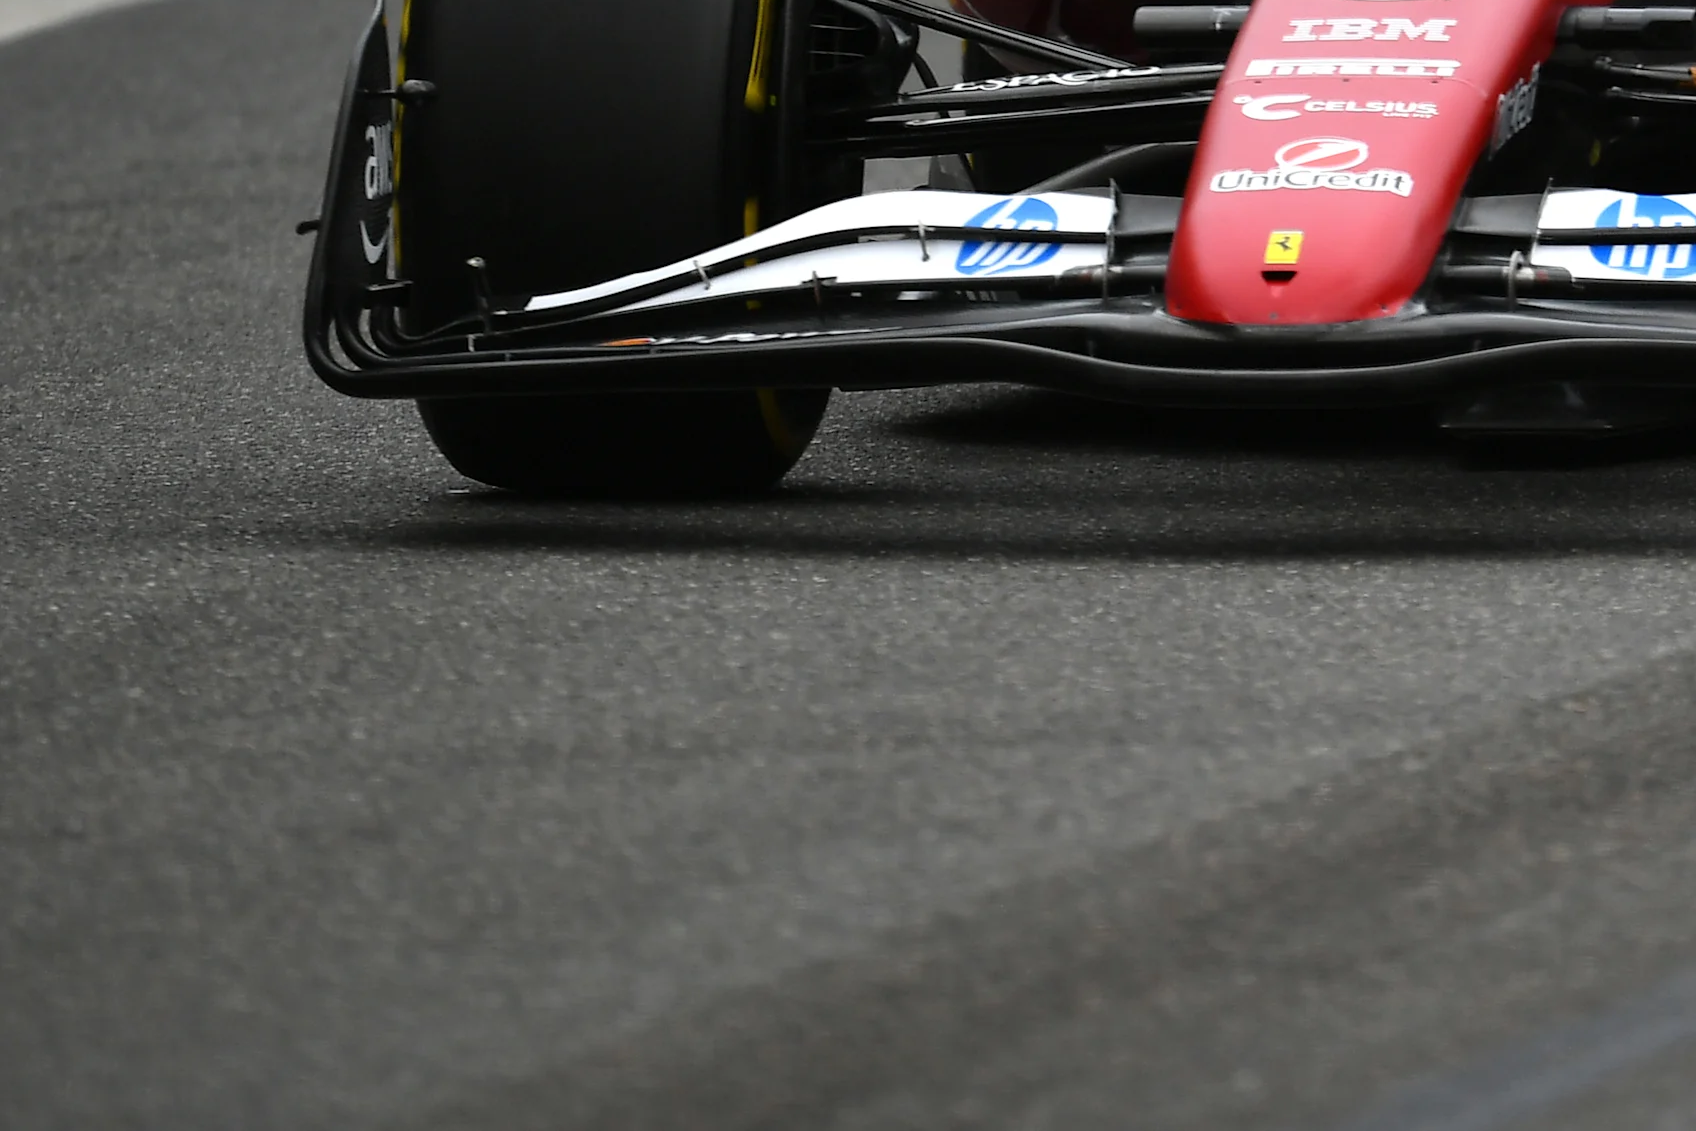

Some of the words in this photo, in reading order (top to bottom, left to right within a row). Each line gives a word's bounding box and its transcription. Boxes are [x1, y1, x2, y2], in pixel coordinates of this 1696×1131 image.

[1282, 18, 1458, 42] IBM
[1245, 58, 1461, 77] PIRELLI
[1304, 100, 1439, 115] CELSIUS
[1216, 170, 1406, 192] UniCredit
[961, 196, 1054, 276] hp
[1608, 195, 1696, 279] hp
